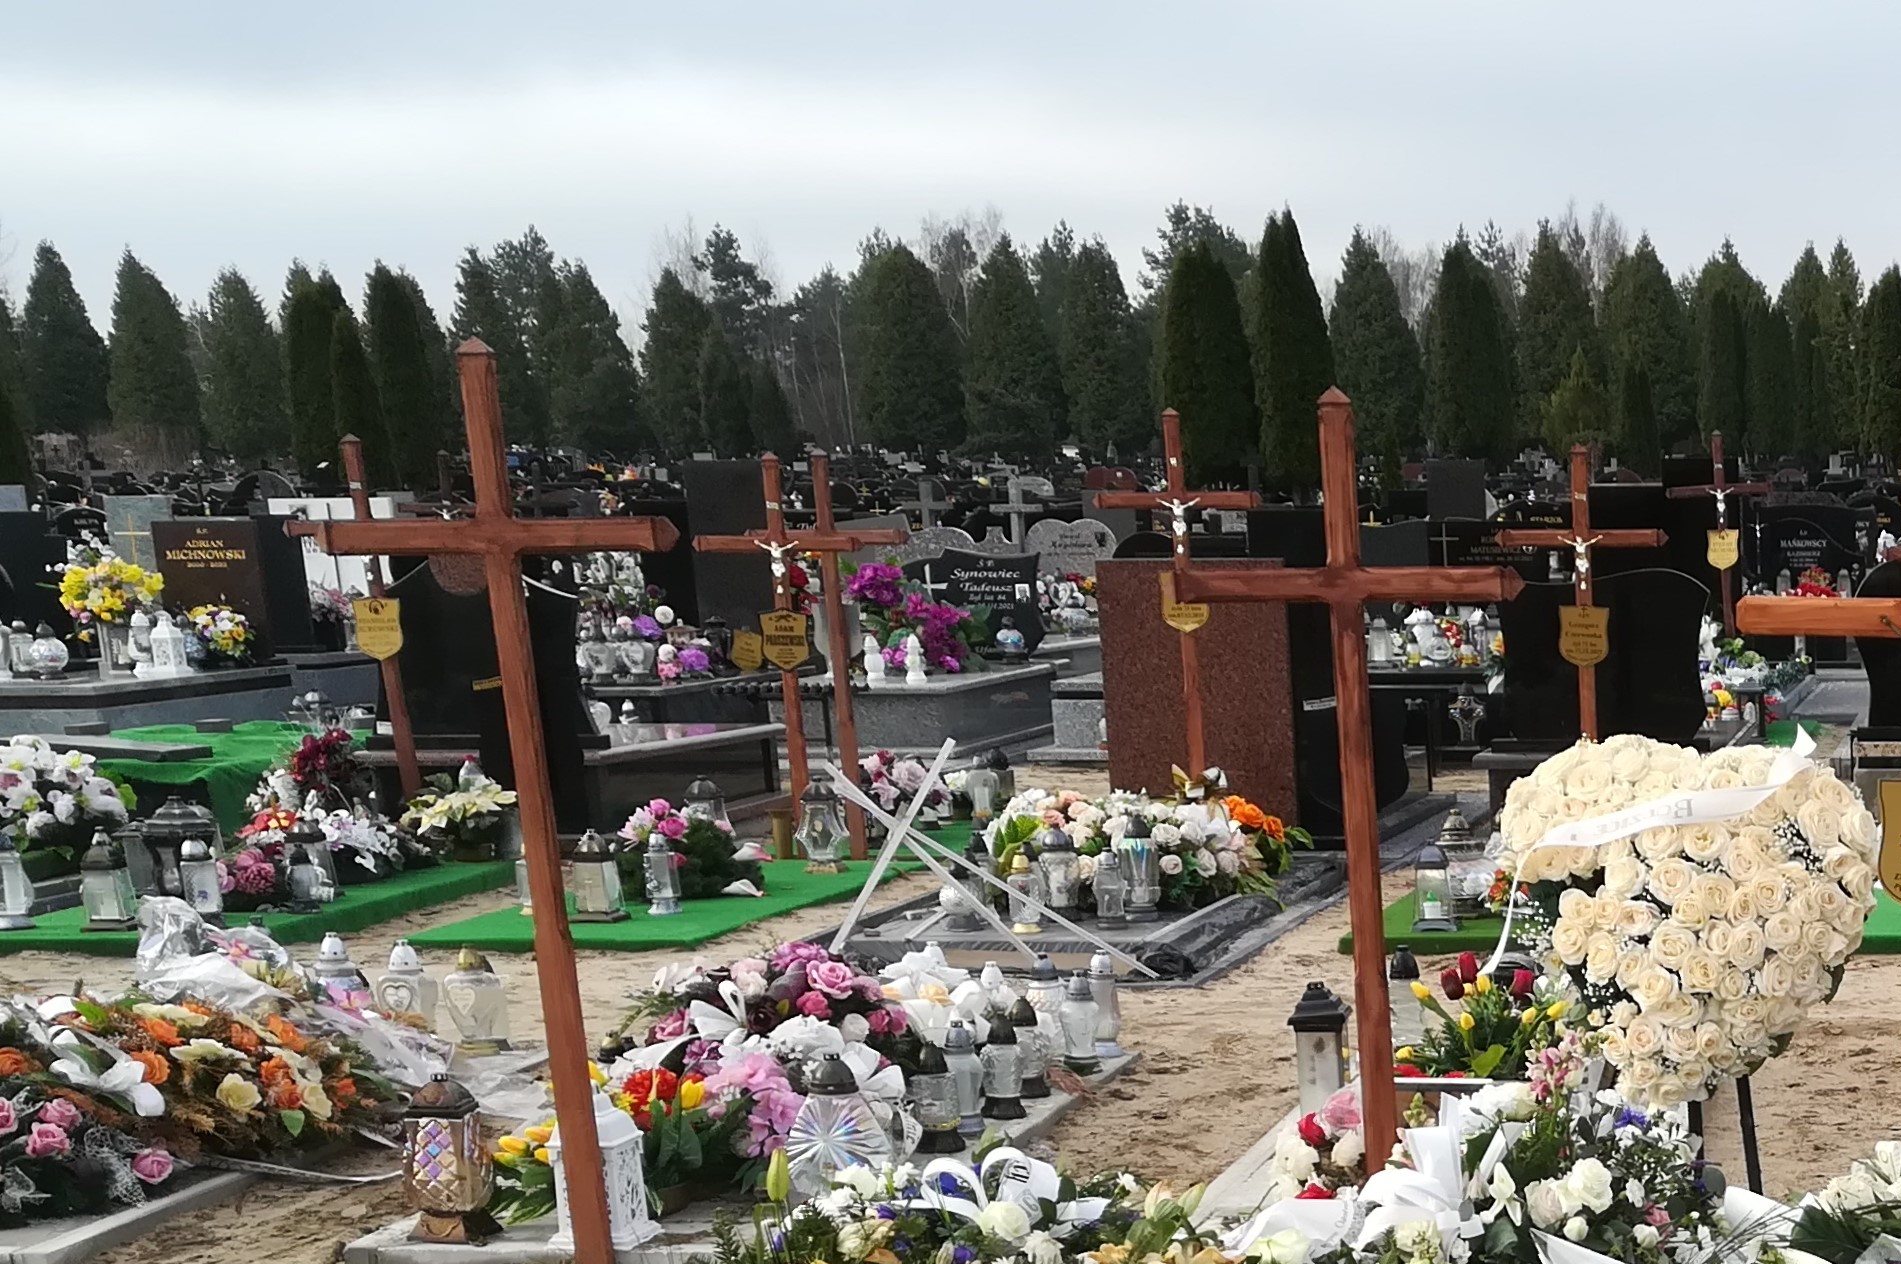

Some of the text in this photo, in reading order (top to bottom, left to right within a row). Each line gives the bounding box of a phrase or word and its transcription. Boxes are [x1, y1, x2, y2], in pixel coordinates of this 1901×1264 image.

[185, 540, 224, 548] ADRIAN
[165, 549, 246, 560] MICHNOWSKI
[950, 568, 1020, 581] Synowiec
[960, 582, 1013, 592] Tadeusz
